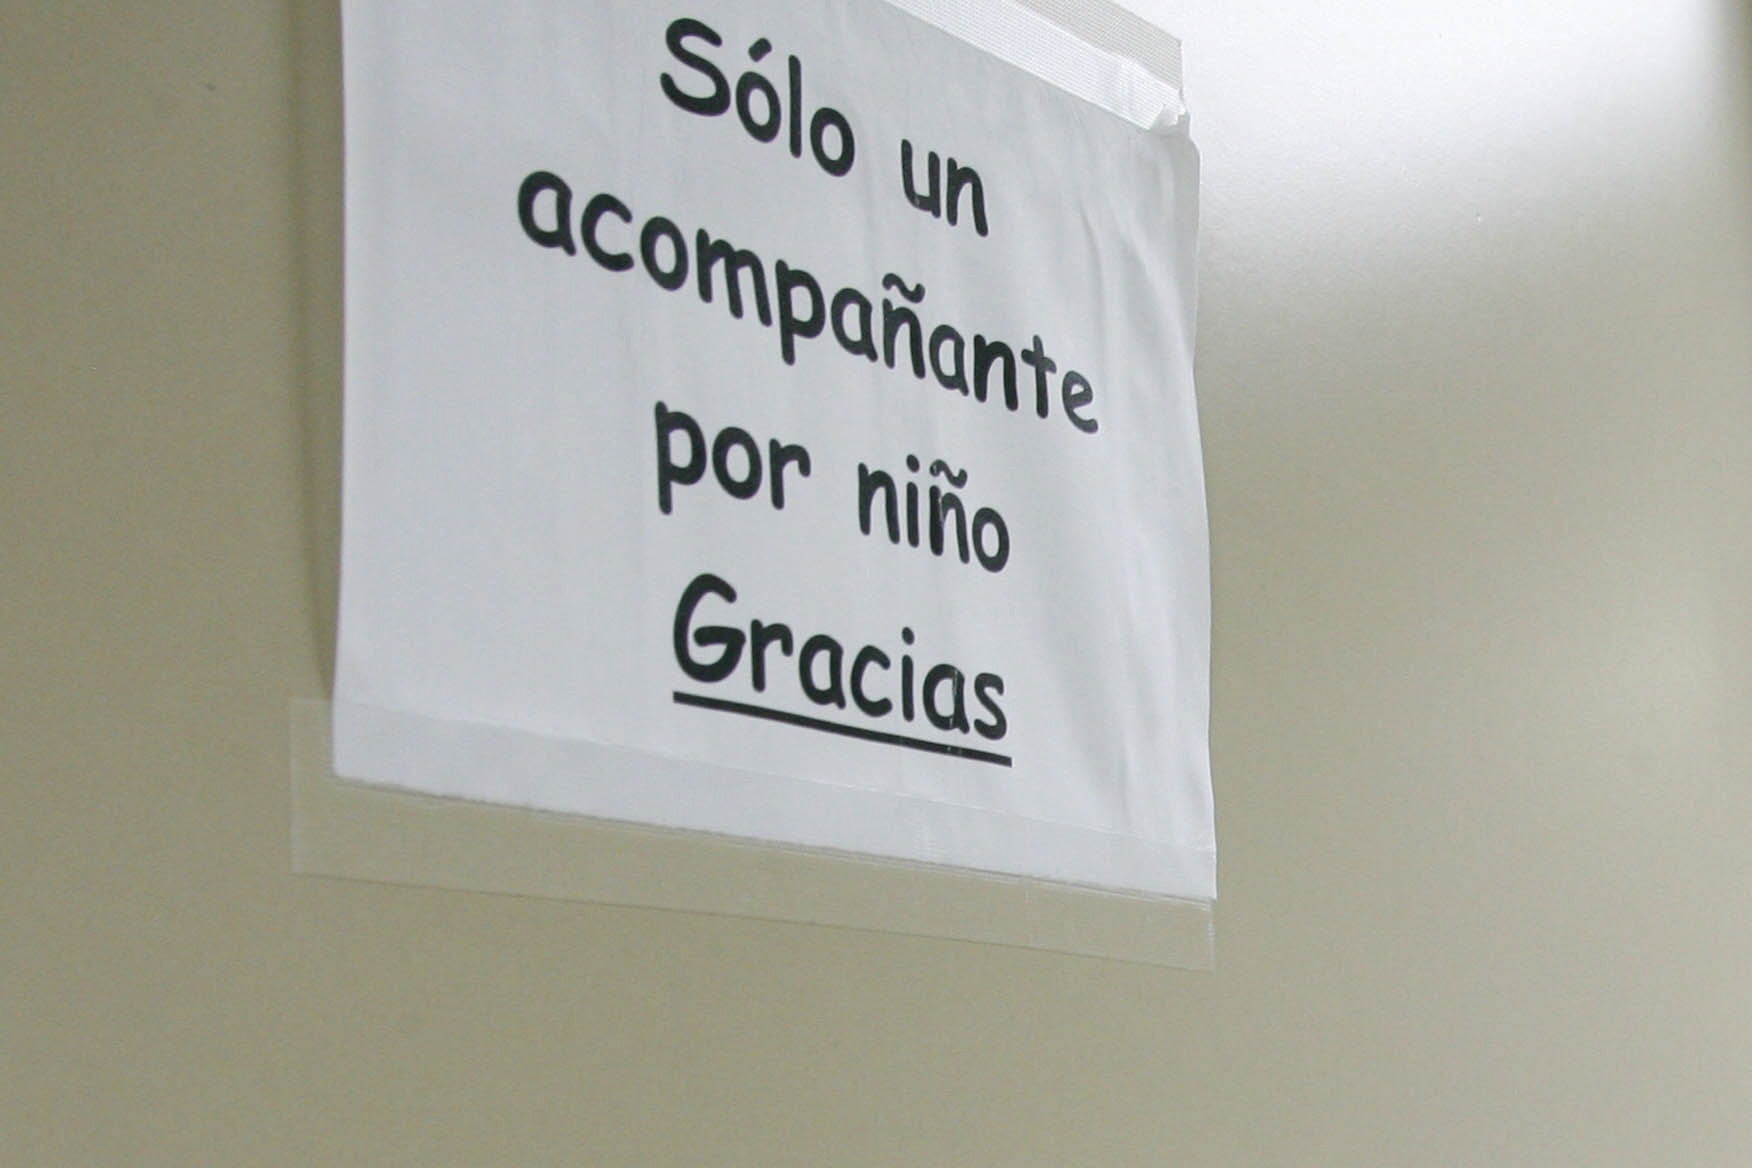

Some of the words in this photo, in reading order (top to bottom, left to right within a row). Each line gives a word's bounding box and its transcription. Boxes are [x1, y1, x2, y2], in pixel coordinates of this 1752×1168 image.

[660, 17, 856, 178] Sólo
[901, 139, 990, 237] un
[517, 170, 1099, 433] acompañante
[654, 401, 812, 515] por
[857, 454, 1011, 574] niño
[673, 573, 1011, 741] Gracias
